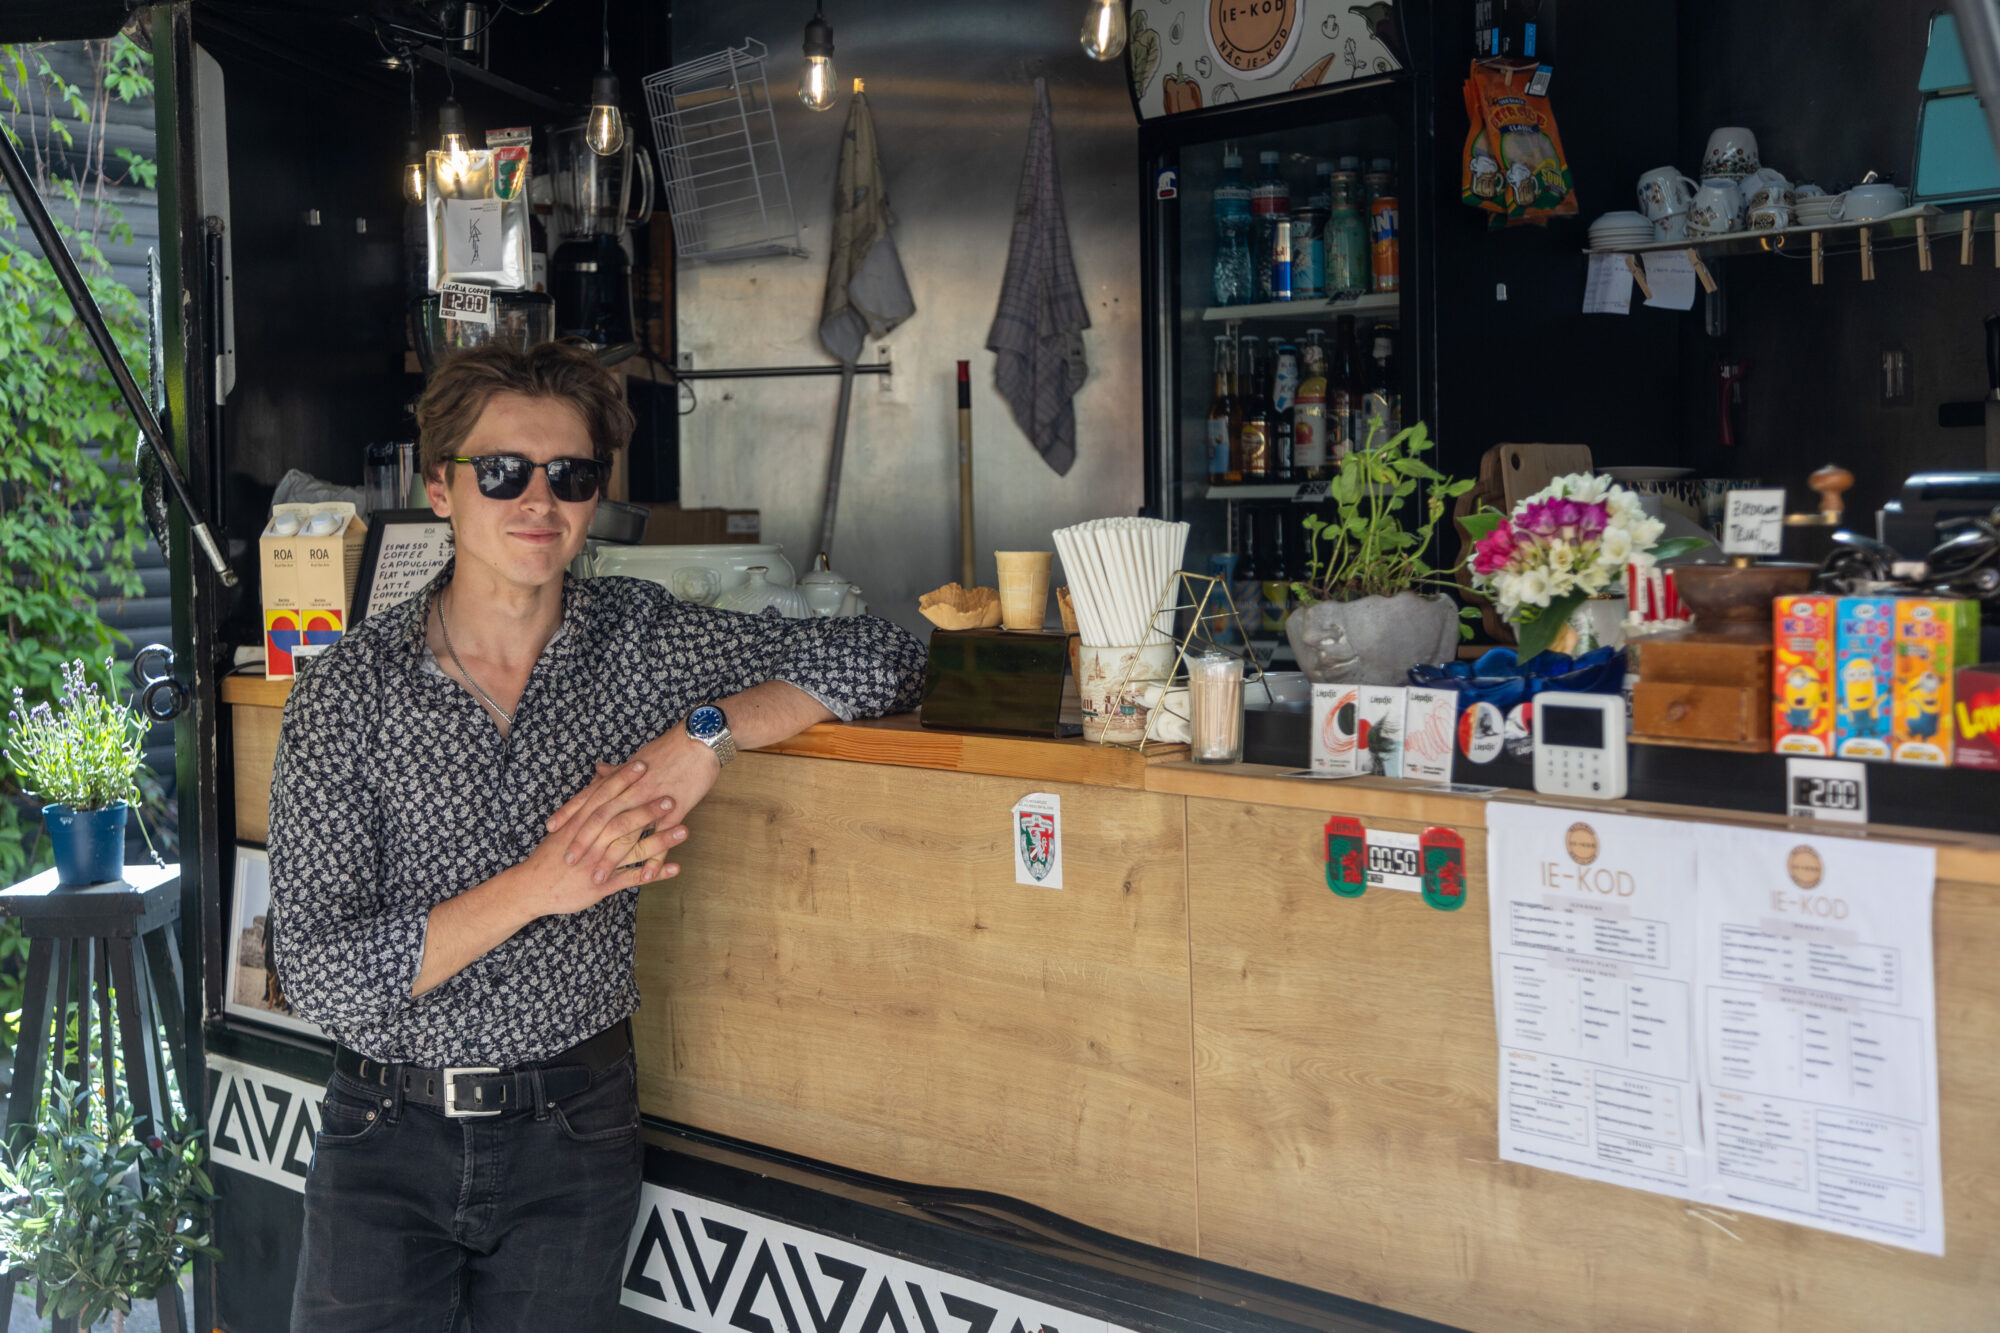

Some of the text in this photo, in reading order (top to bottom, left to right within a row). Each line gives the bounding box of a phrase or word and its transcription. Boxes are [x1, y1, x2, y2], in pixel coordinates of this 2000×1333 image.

[1223, 0, 1283, 22] IE-KOD
[451, 294, 483, 312] 12.00
[385, 542, 428, 551] ESPRESSO
[273, 549, 293, 561] ROA
[309, 548, 330, 560] ROA
[383, 550, 424, 560] COFFEE
[380, 559, 444, 570] CAPPUCCINO
[379, 568, 429, 580] FLAT WHITE
[375, 580, 411, 591] LATTE
[371, 602, 392, 611] TEA
[1809, 778, 1857, 809] 2.00
[1369, 846, 1417, 876] 00.50
[1540, 861, 1635, 897] IE-KOD
[1770, 890, 1849, 920] IE-KOD
